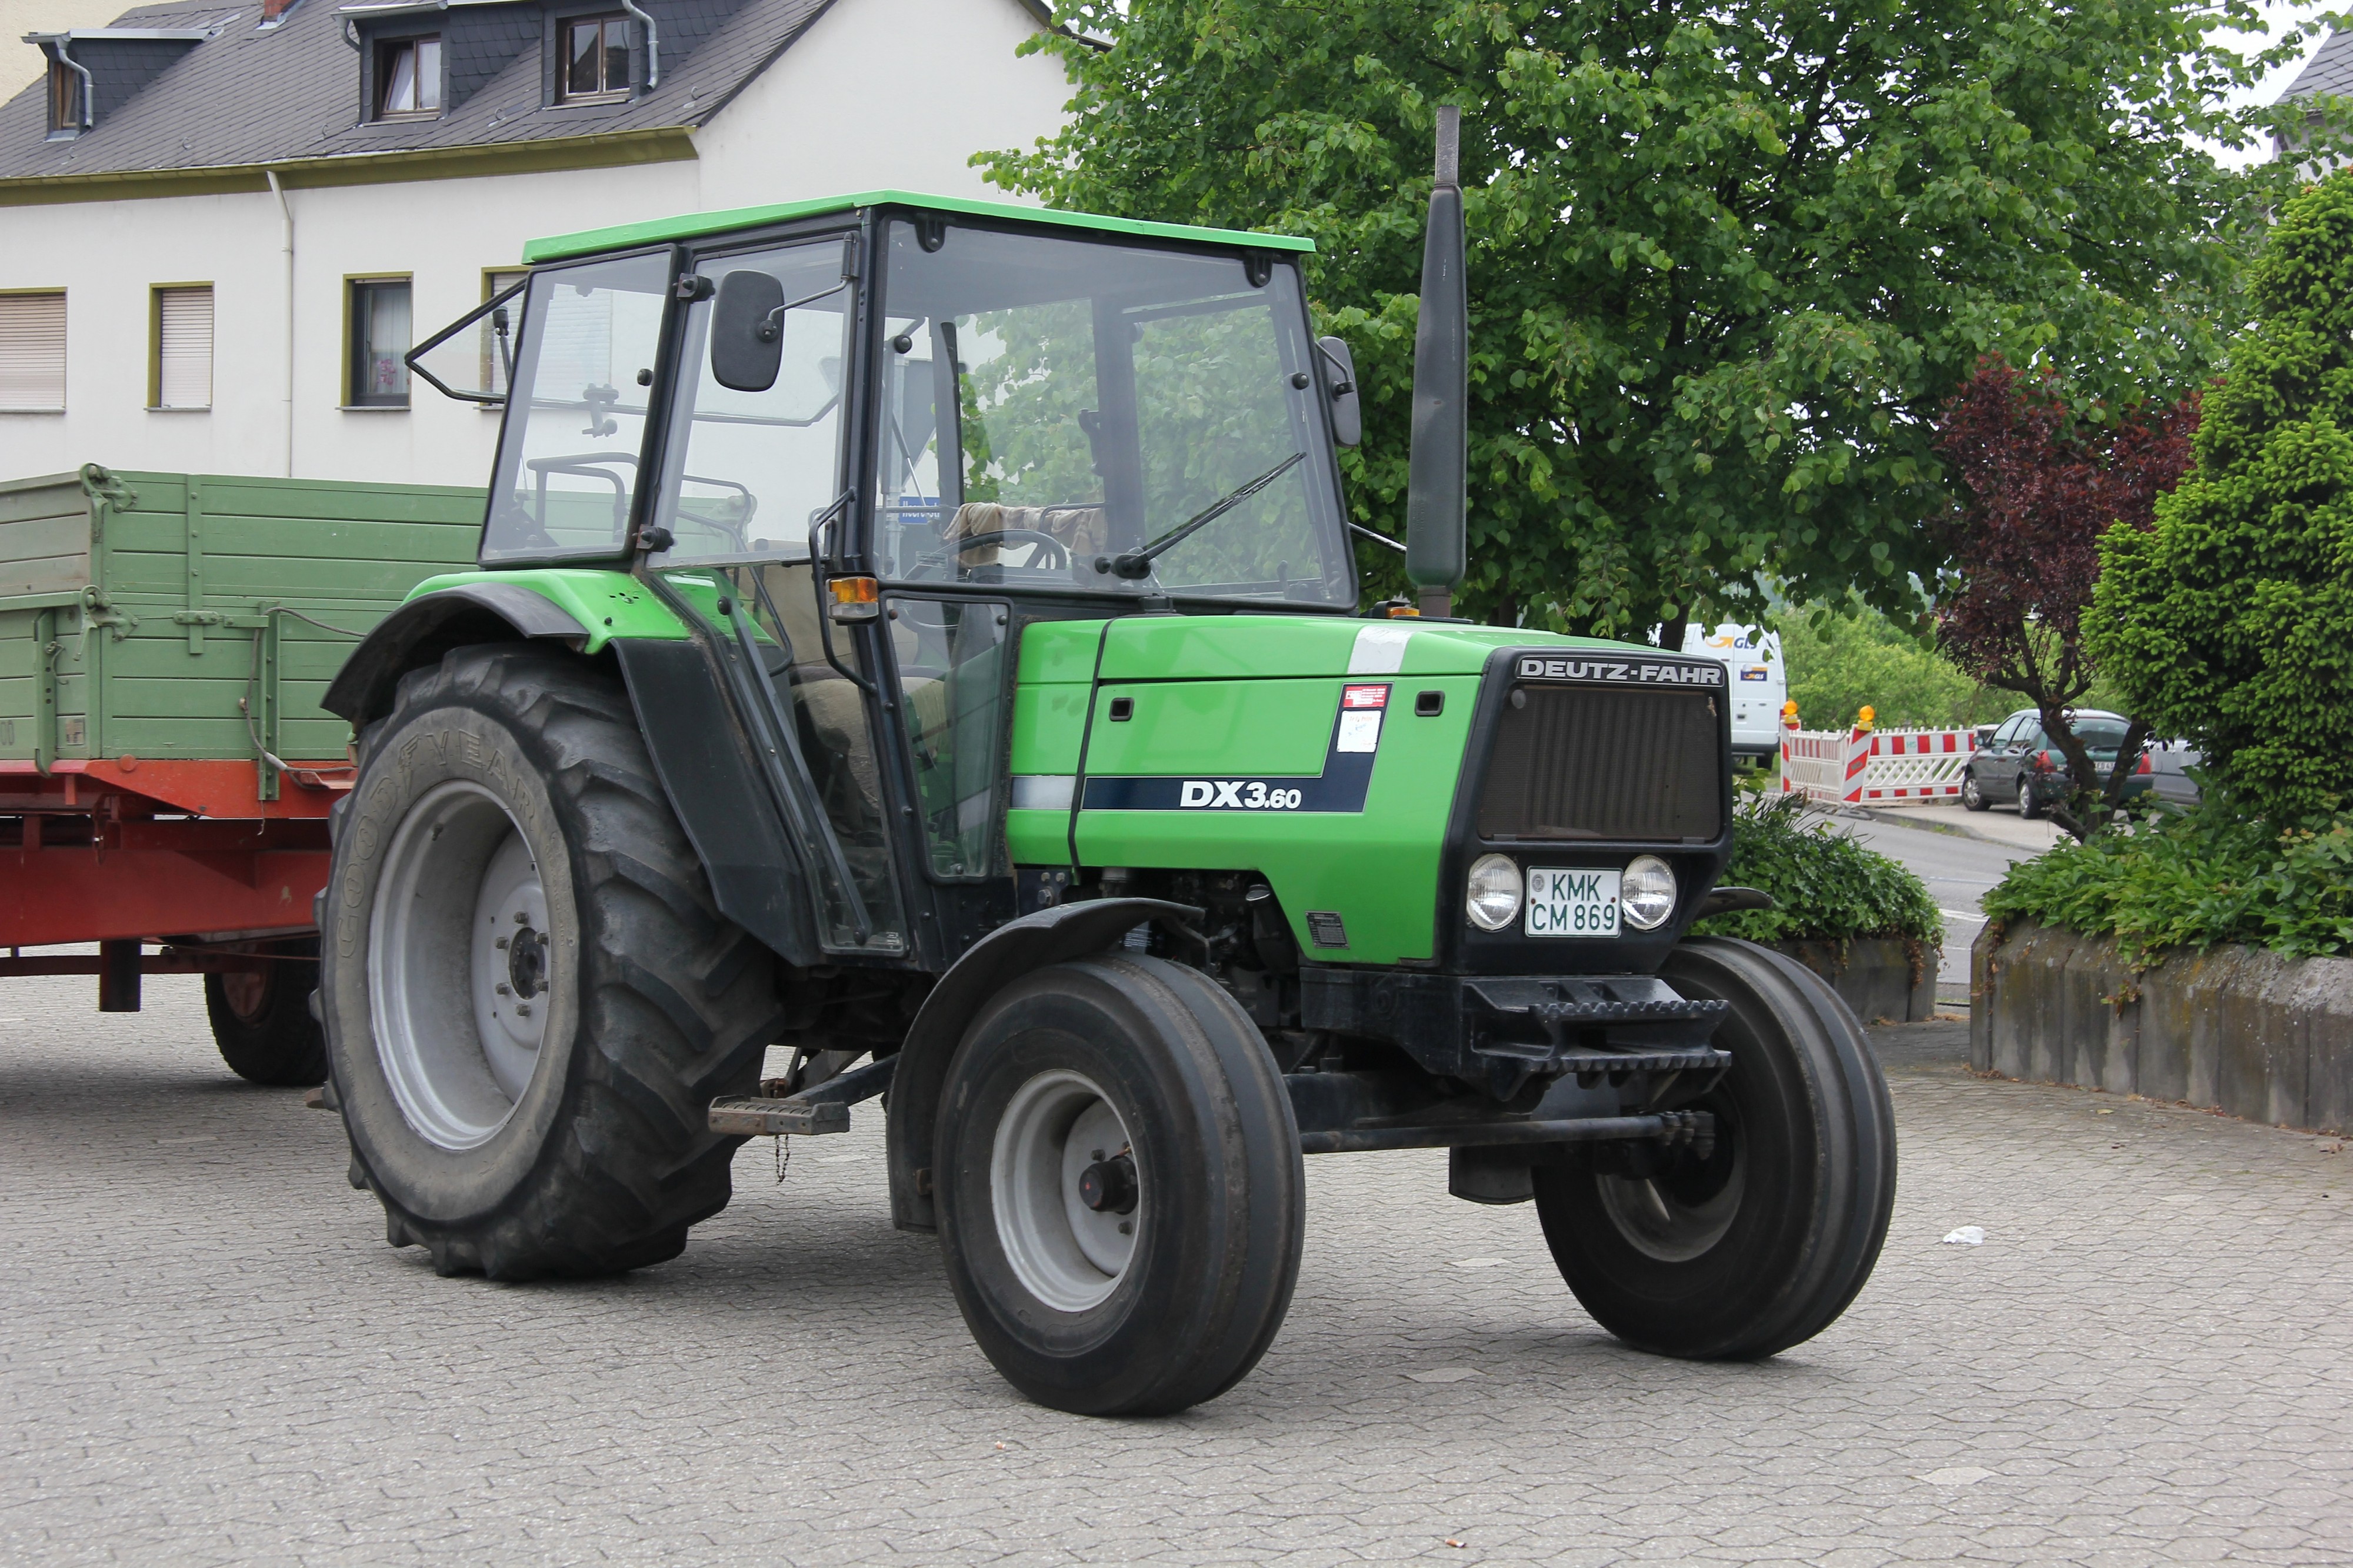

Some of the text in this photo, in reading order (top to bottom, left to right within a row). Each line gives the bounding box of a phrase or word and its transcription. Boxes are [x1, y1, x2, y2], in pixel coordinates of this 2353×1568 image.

[1520, 659, 1720, 684] DEUTZ-FAHR
[1180, 781, 1302, 809] DX3.60
[1552, 874, 1601, 901] KMK
[1532, 903, 1615, 930] CM 869
